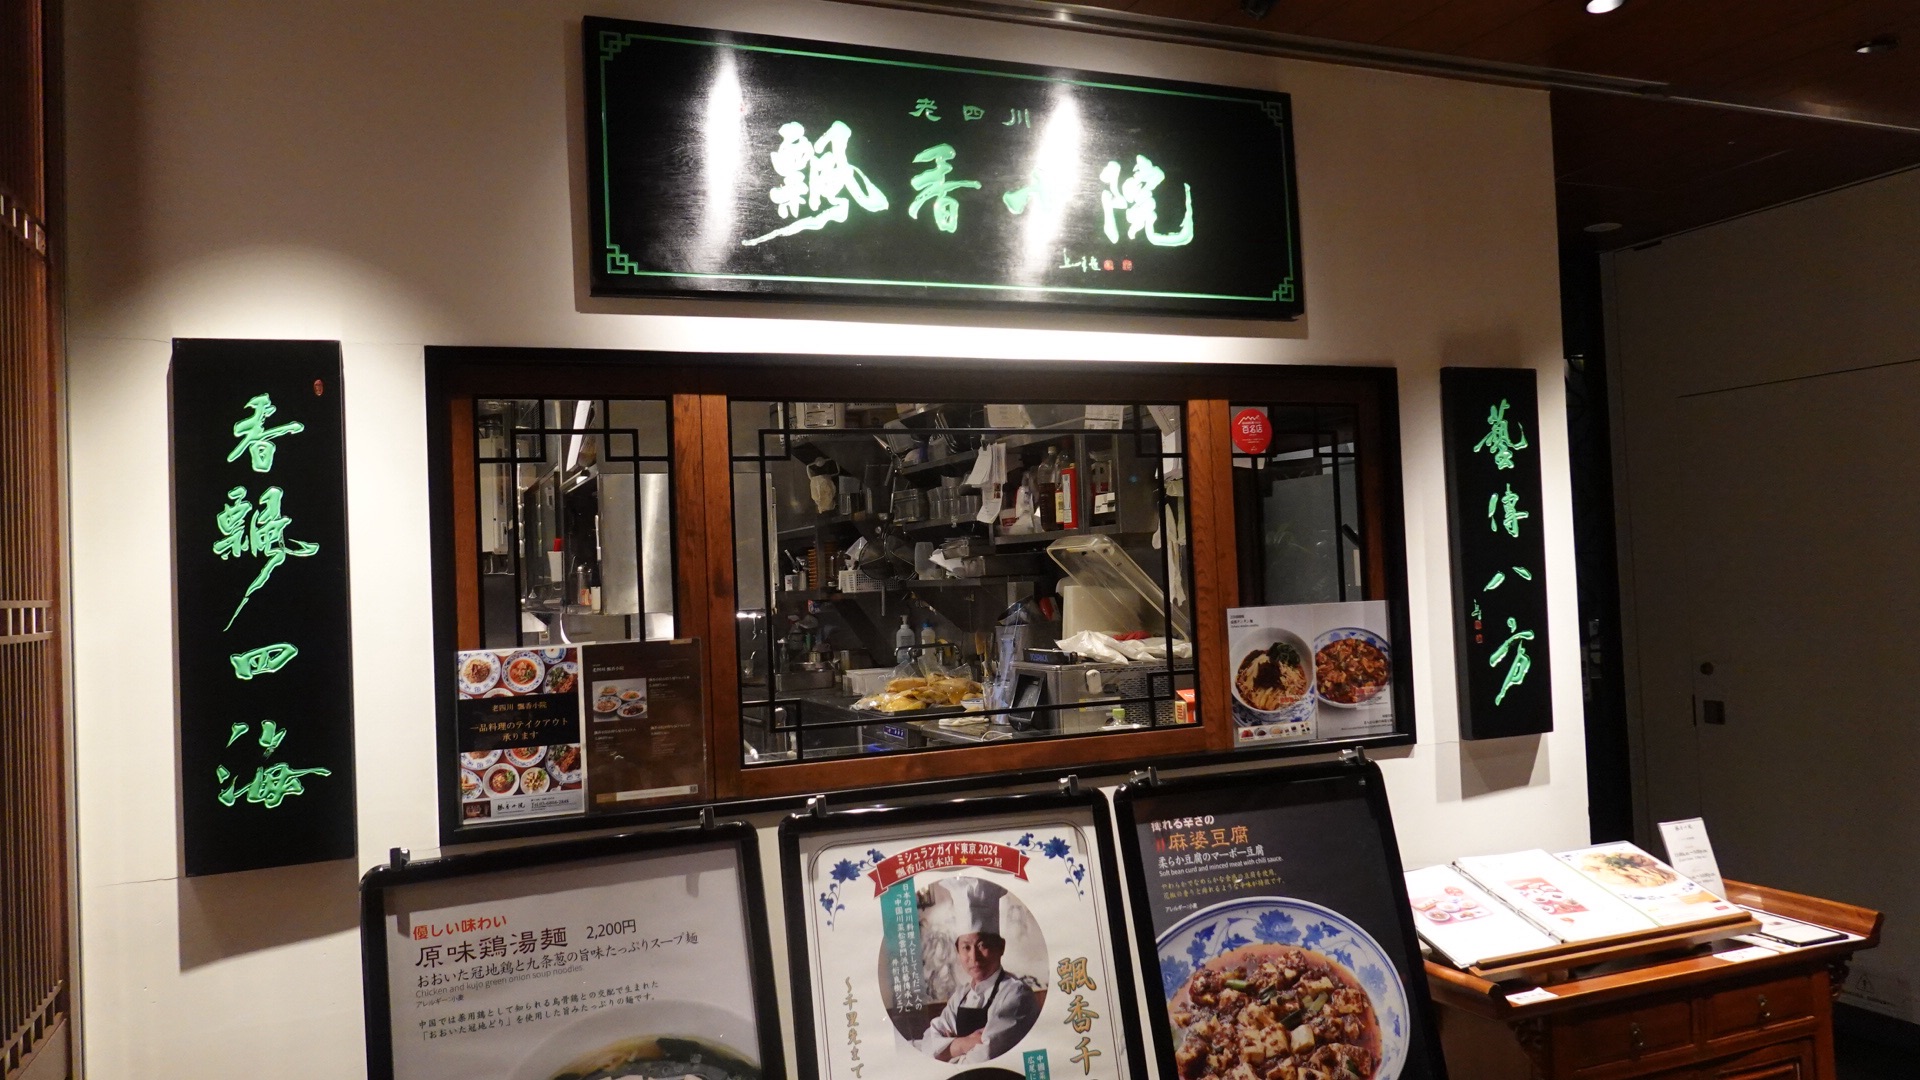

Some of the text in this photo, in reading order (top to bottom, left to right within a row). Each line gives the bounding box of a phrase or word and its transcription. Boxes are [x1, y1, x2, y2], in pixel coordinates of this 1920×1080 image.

[909, 98, 1031, 128] 老四川
[1474, 398, 1535, 706] 藝傳八方
[213, 393, 332, 808] 香飄四海
[470, 718, 568, 732] 一品料理のテイクアウト
[503, 731, 538, 742] 承ります
[1168, 825, 1249, 852] 麻婆豆腐
[897, 842, 998, 865] ミシュランガイド東京 2024
[973, 856, 1003, 868] 一つ星
[1158, 844, 1265, 869] 柔らか豆腐のマーボー豆腐
[1159, 869, 1171, 877] Soft
[1171, 867, 1185, 876] bean
[1185, 865, 1198, 874] curd
[1198, 864, 1209, 872] and
[1209, 861, 1229, 871] minced
[1229, 860, 1243, 868] meat
[1243, 858, 1255, 866] with
[1255, 856, 1267, 865] chili
[413, 915, 507, 941] 優しい味わい
[415, 919, 637, 968] 原味鶏湯麺 2,200円
[902, 883, 923, 1011] 日本の四川料理人としてただ一人の
[417, 931, 699, 988] おおいた冠地鶏と九条葱の旨味たっぷりスープ麺
[415, 964, 583, 998] Chicken and kujo green onion soup noodles
